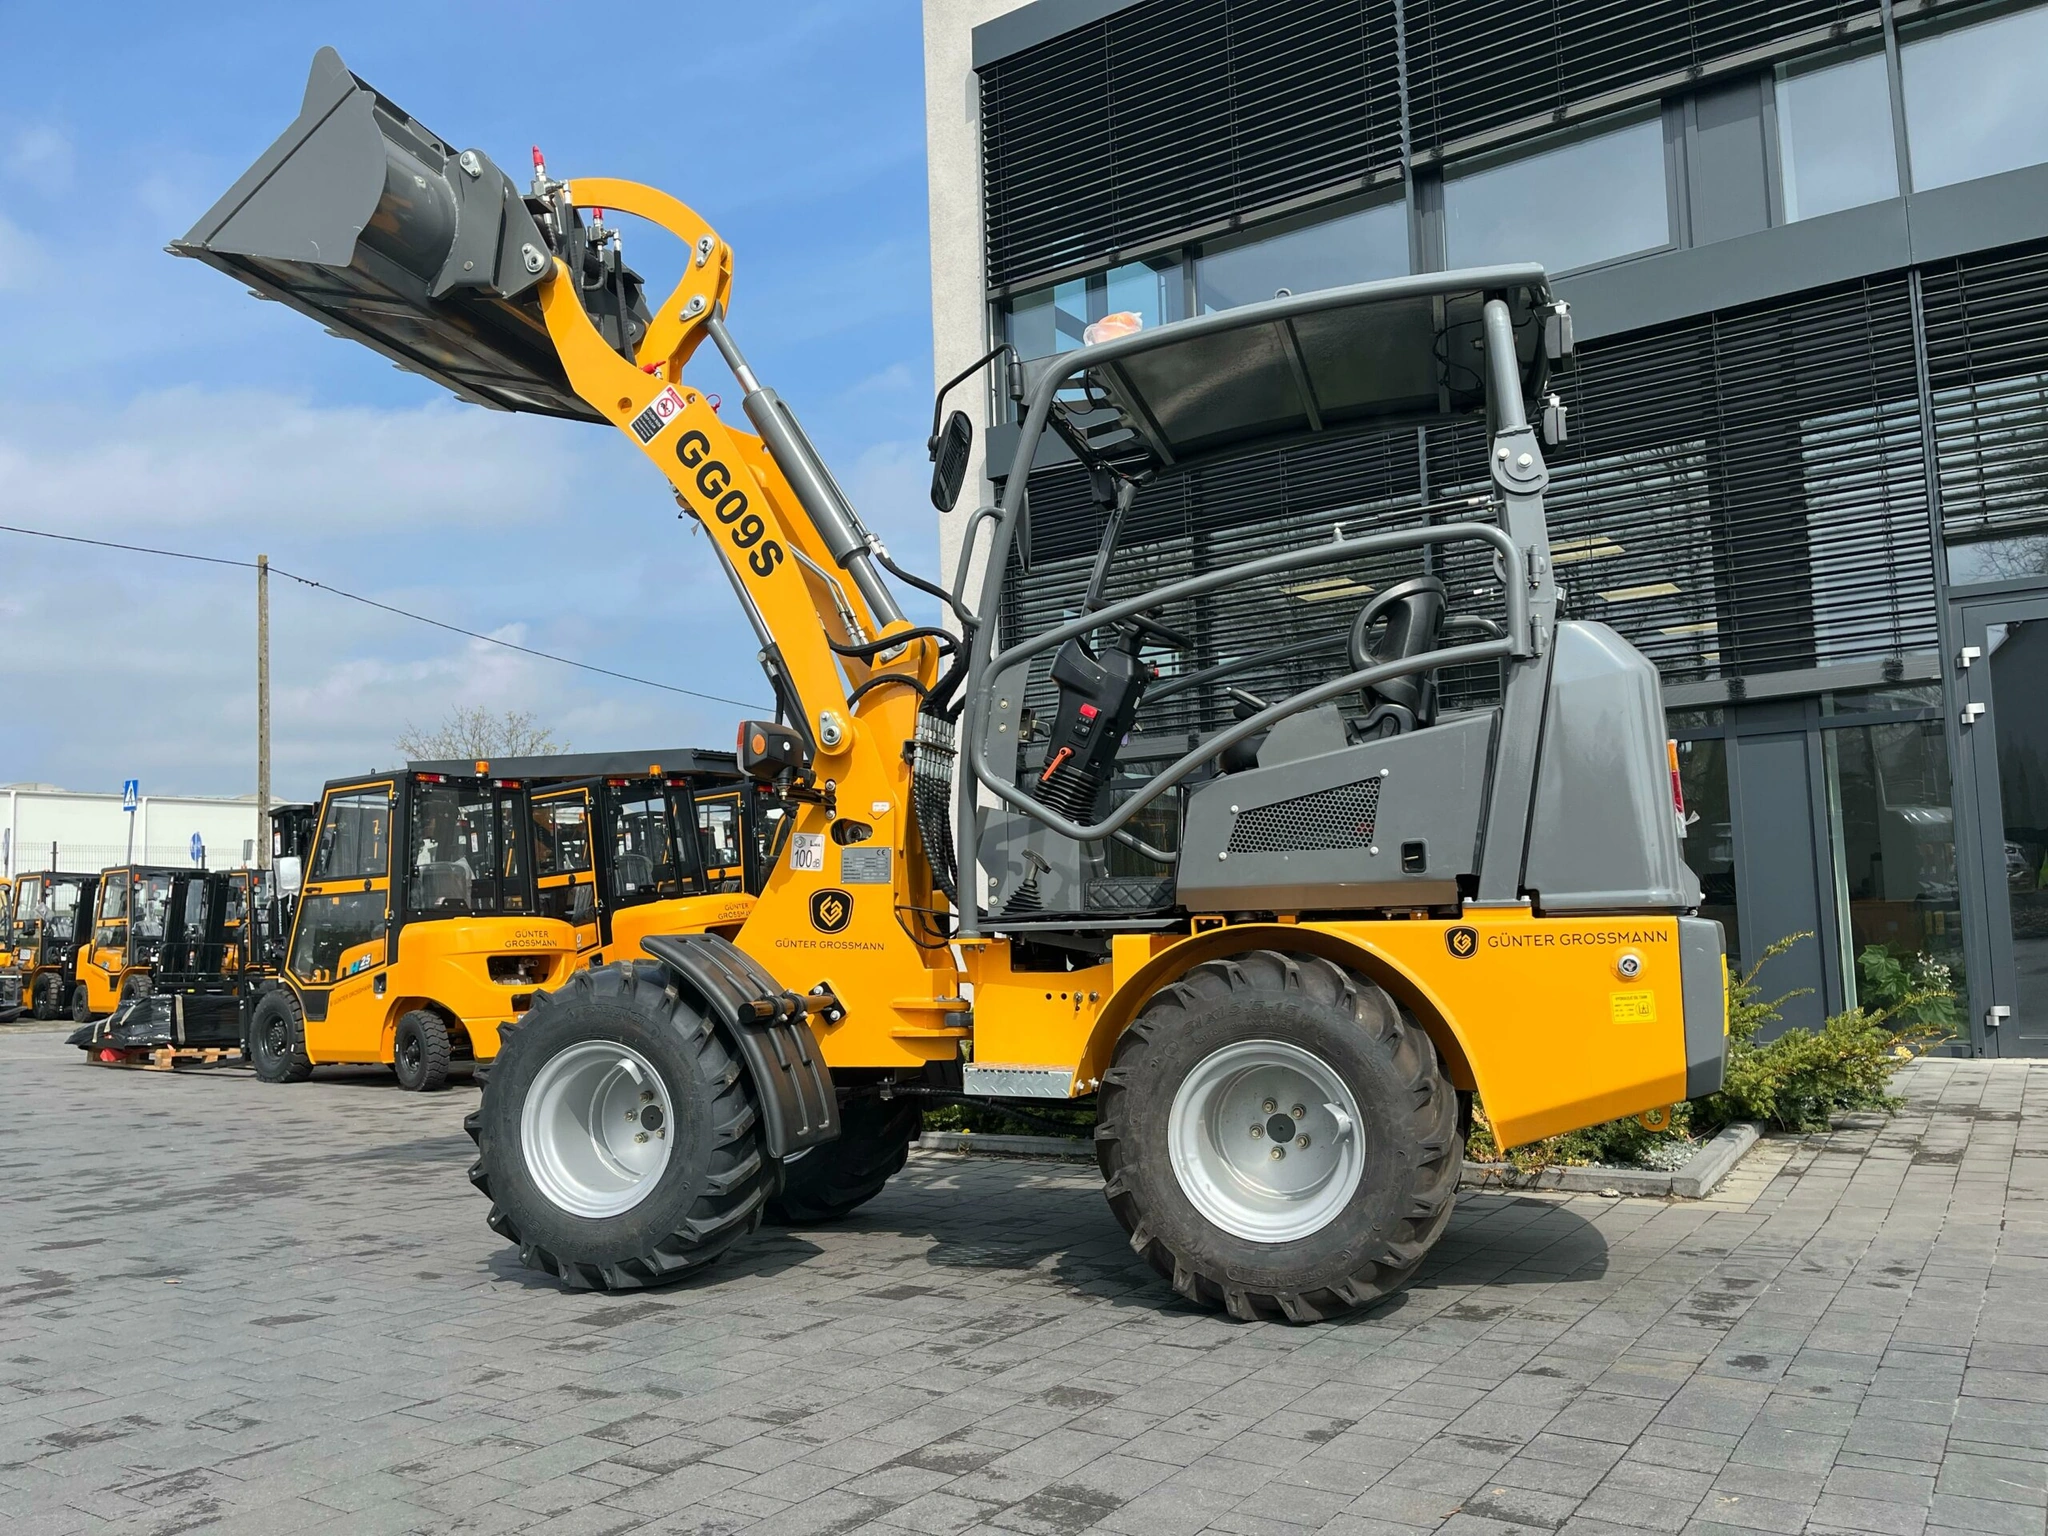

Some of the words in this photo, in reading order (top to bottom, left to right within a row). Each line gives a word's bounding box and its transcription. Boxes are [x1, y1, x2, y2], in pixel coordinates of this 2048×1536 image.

[676, 430, 784, 577] GG09S
[795, 849, 812, 868] 100
[515, 929, 549, 938] GÜNTER
[1487, 931, 1556, 948] GÜNTER
[1559, 930, 1669, 946] GROSSMANN
[505, 939, 557, 948] GROSSMANN
[775, 937, 817, 949] GÜNTER
[819, 940, 885, 951] GROSSMANN
